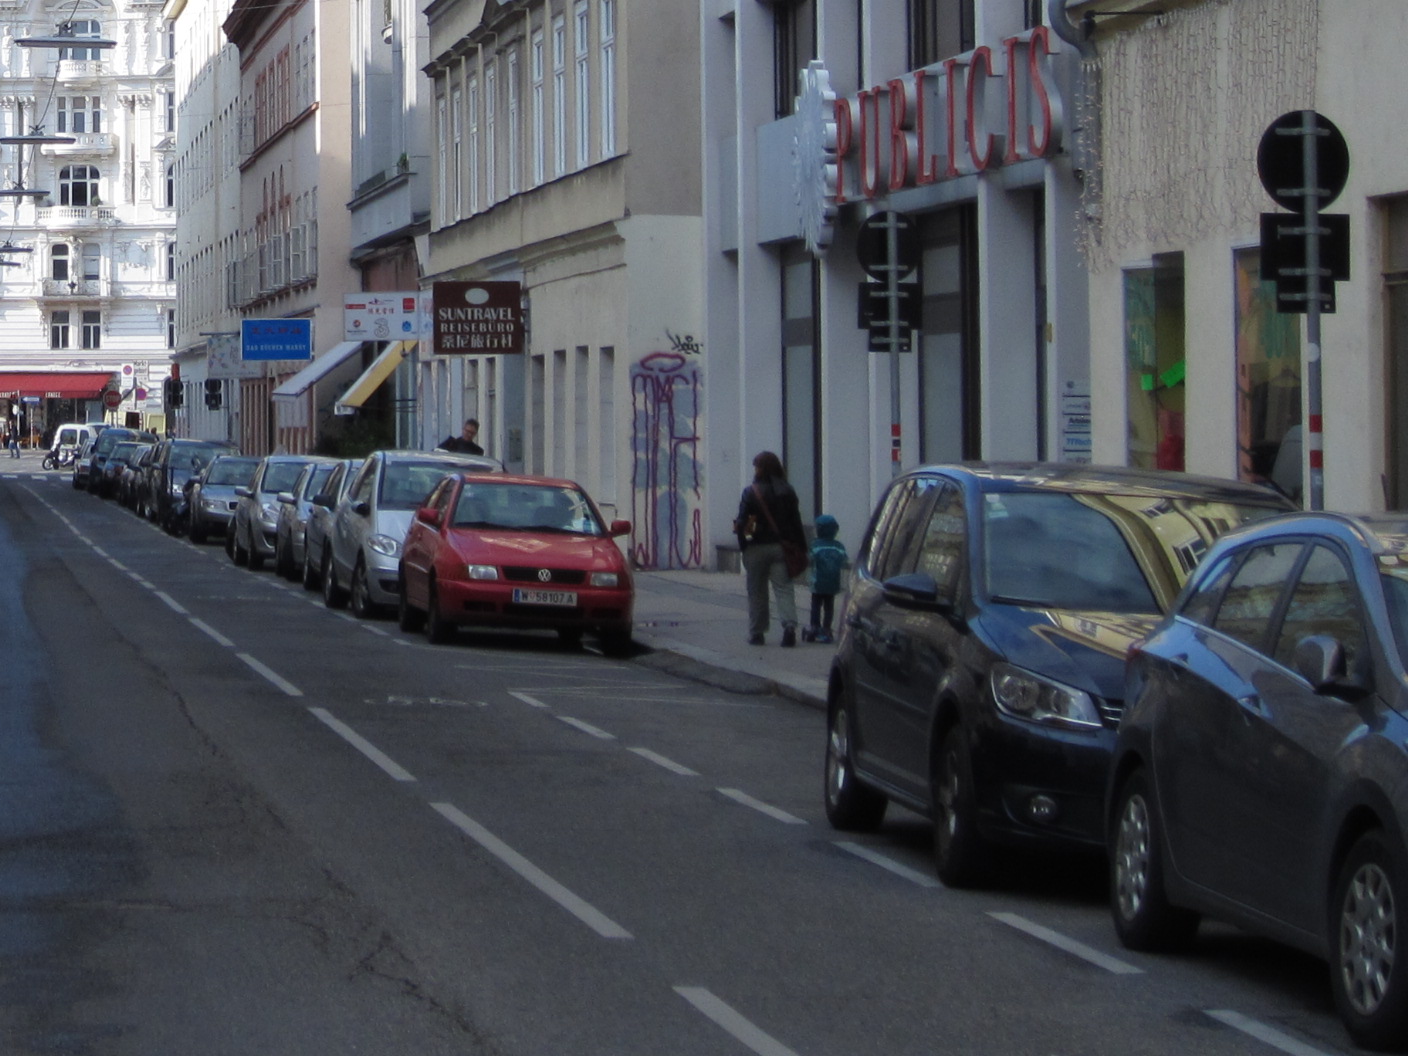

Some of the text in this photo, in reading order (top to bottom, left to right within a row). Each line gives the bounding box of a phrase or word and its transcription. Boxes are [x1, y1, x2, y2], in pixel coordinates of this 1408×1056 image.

[834, 25, 1052, 203] PUBLICIS
[438, 307, 515, 320] SUNTRAVEL
[440, 320, 515, 333] REISEBÜRO
[521, 591, 574, 603] W 58107 A
